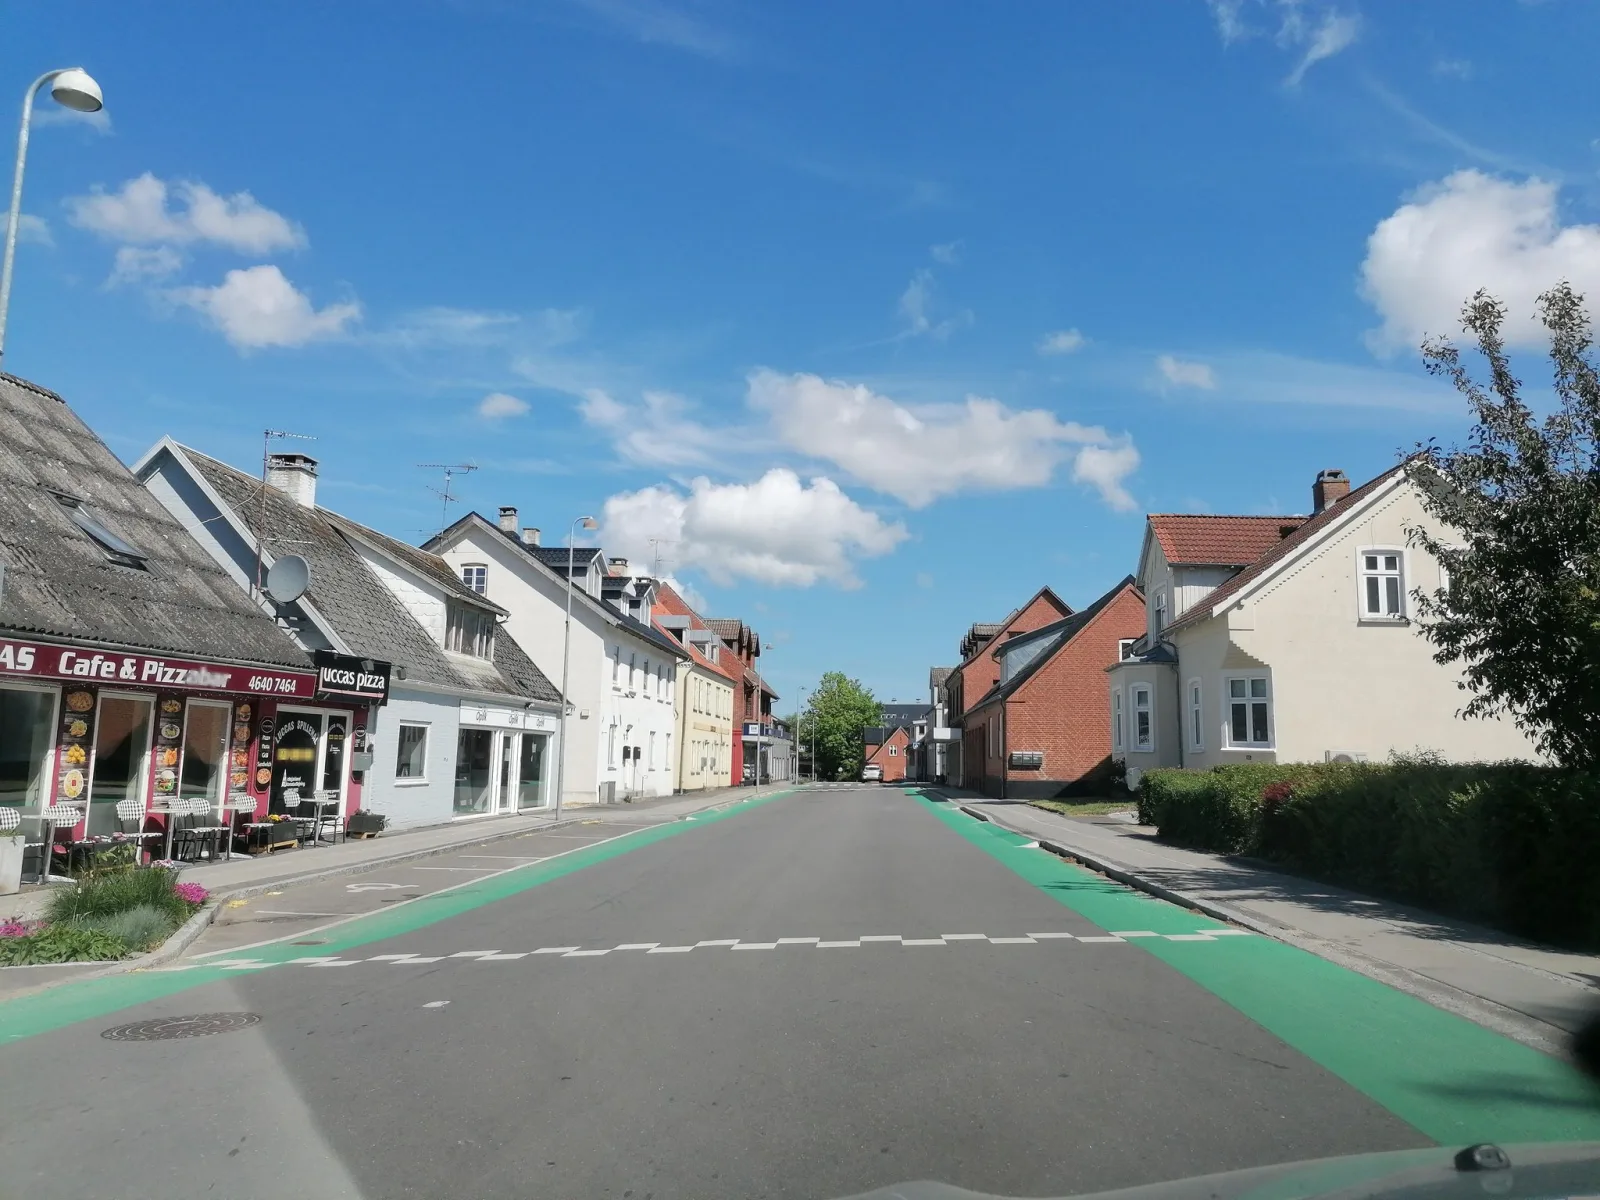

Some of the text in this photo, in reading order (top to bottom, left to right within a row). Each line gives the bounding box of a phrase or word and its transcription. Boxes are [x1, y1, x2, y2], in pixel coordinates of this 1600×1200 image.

[58, 651, 116, 677] Cafe
[119, 658, 137, 680] &
[248, 675, 272, 691] 4640
[275, 678, 297, 693] 7464
[356, 671, 385, 691] pizza
[275, 720, 294, 744] LUCCAS
